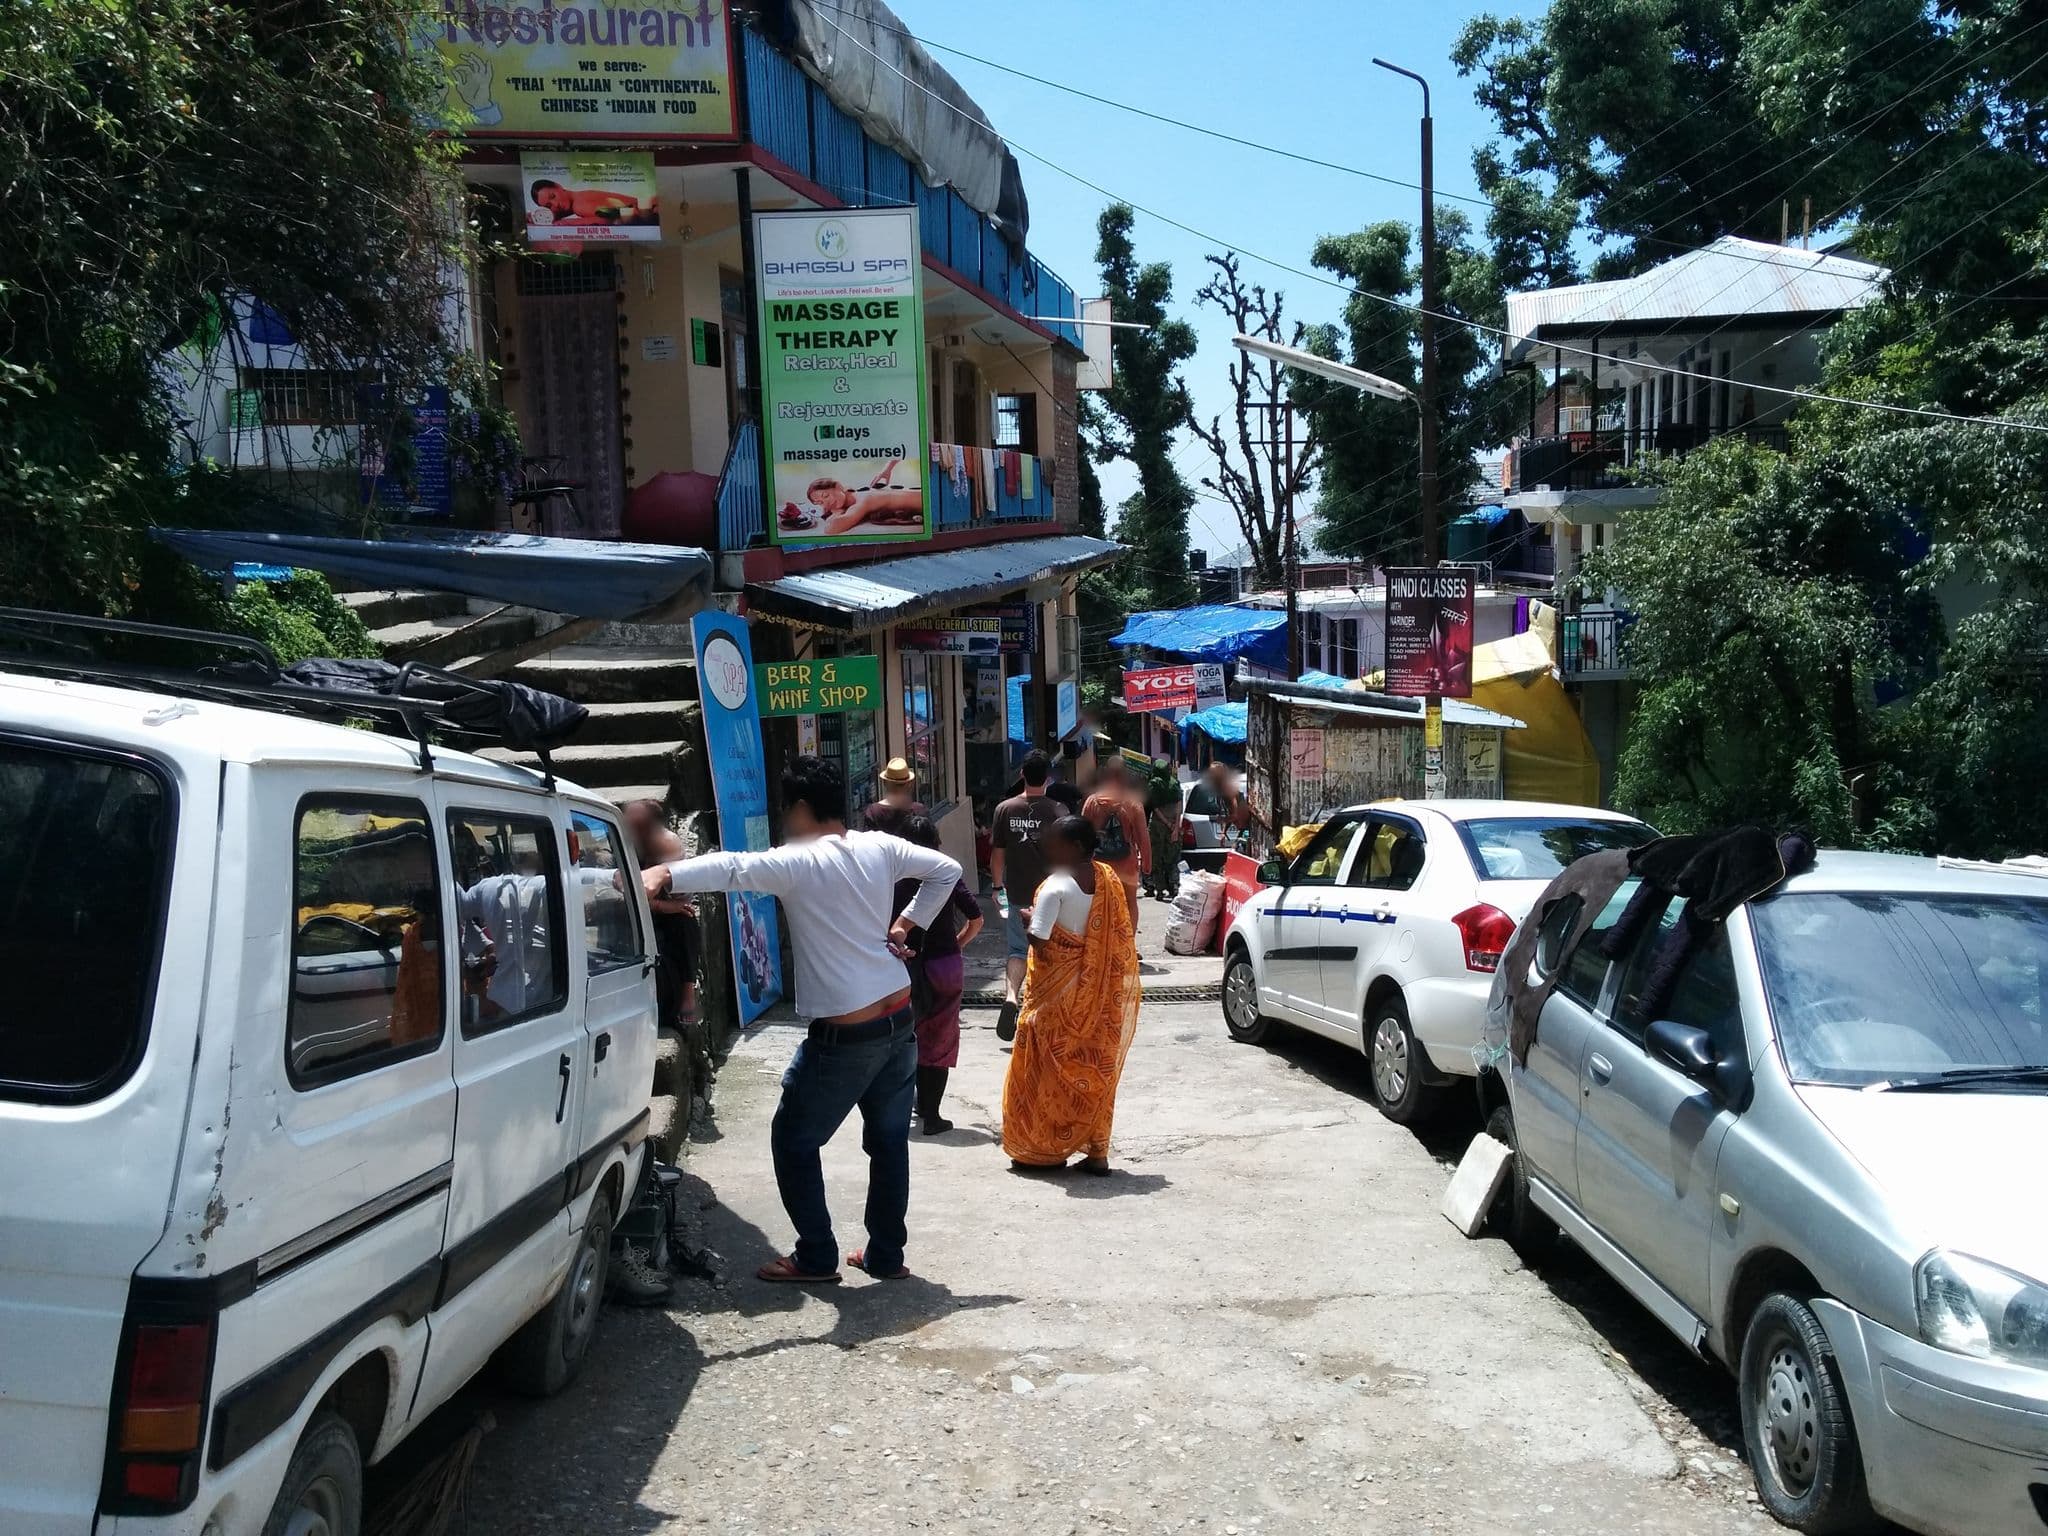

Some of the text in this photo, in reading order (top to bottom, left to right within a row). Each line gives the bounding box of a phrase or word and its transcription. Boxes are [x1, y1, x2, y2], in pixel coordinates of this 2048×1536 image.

[446, 0, 714, 48] Restaurant
[578, 60, 599, 72] we
[541, 98, 598, 113] CHINESE
[663, 99, 697, 115] FOOD
[765, 259, 908, 275] BHAGSU SPA
[773, 301, 899, 322] MASSAGE
[776, 329, 899, 350] THERAPY
[833, 377, 850, 393] &
[778, 401, 908, 420] Rejeuvenate
[836, 425, 870, 441] days
[783, 444, 906, 461] massage course)
[1390, 578, 1467, 598] HINDI CLASSES
[935, 618, 971, 632] GENERAL
[972, 619, 999, 632] STORE
[938, 637, 965, 652] Cake
[722, 662, 746, 698] SPA
[767, 662, 837, 687] BEER &
[980, 673, 998, 681] TAXI
[1197, 667, 1221, 678] YOGA
[769, 685, 868, 711] WINE SHOP
[802, 718, 814, 729] TAXI
[1009, 819, 1042, 829] BUNGY
